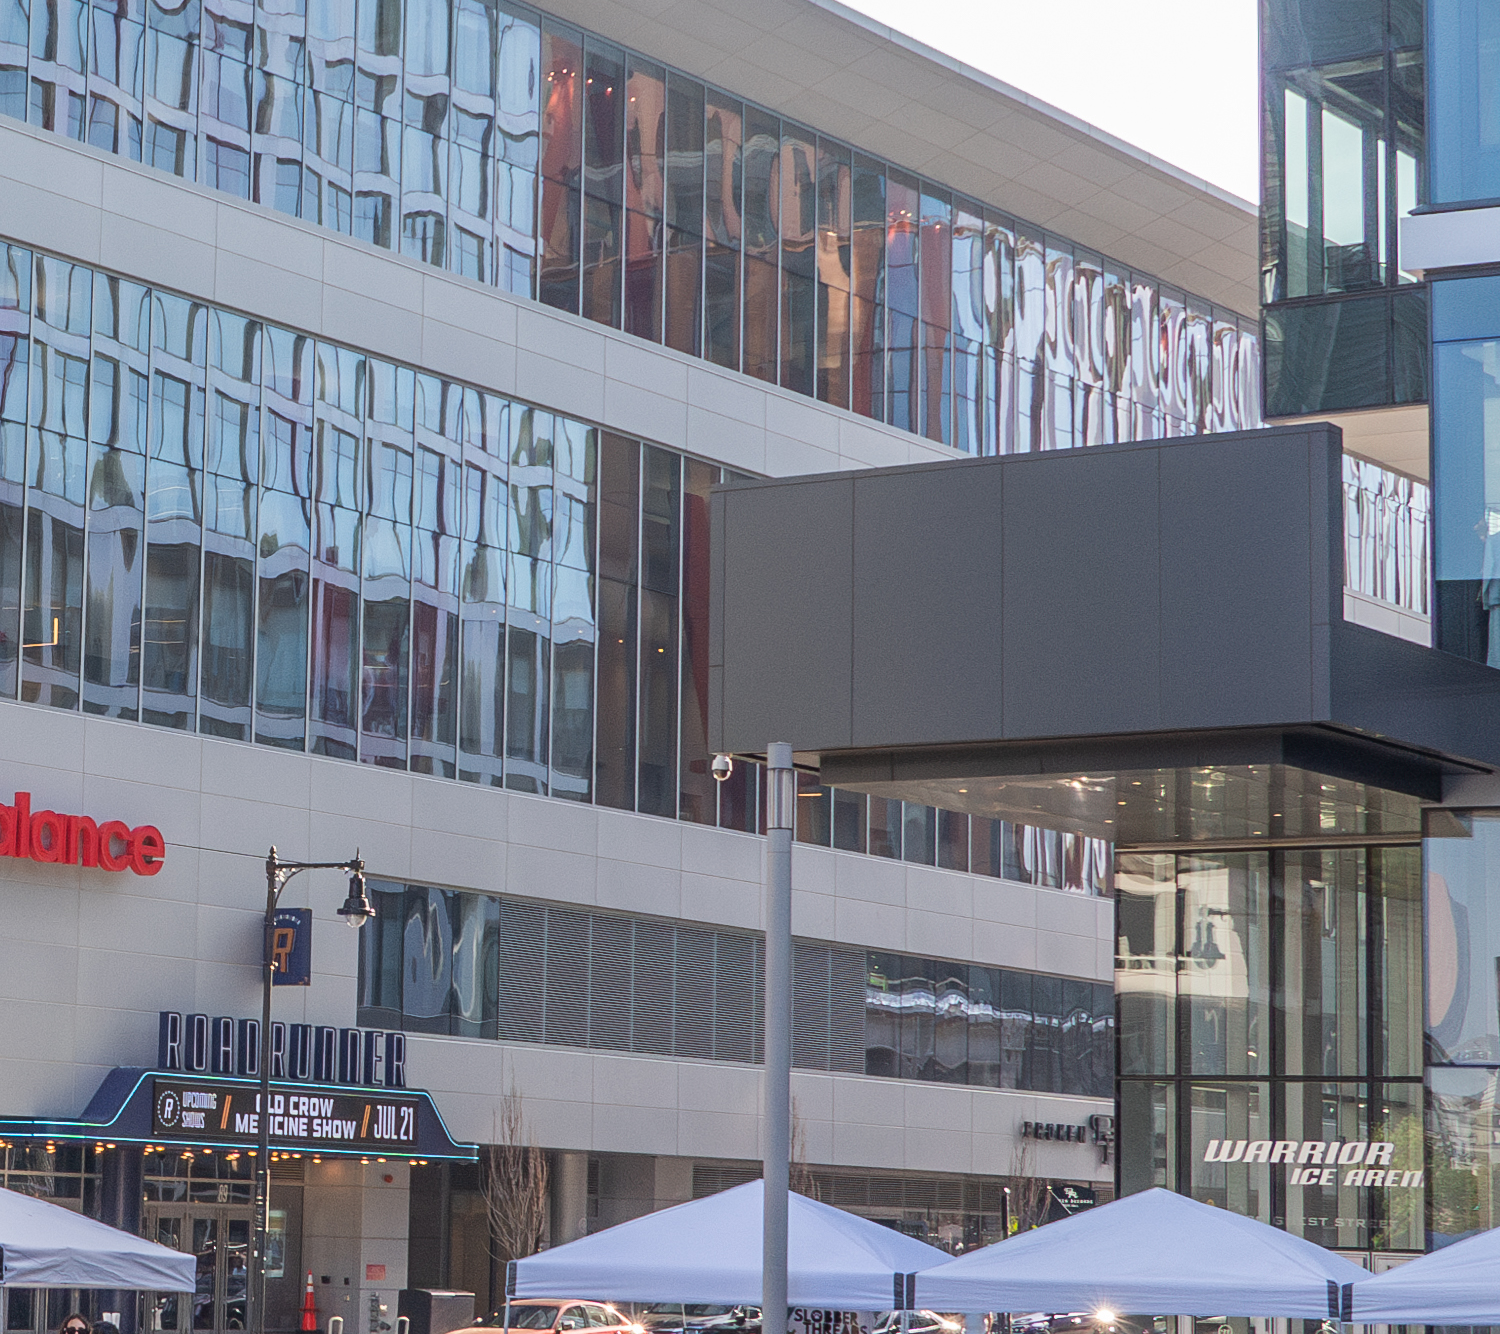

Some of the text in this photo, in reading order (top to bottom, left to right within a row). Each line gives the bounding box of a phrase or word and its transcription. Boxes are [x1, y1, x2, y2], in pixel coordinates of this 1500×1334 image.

[159, 1011, 407, 1088] ROADRUNNER
[182, 1091, 217, 1110] UPCOMING
[289, 1095, 334, 1118] CROW
[182, 1111, 206, 1129] SHOWS
[235, 1113, 357, 1140] MEICINE SHOW
[374, 1105, 414, 1141] JUL 21
[1203, 1139, 1395, 1166] WARRIOR
[1289, 1167, 1425, 1188] ICE AREN
[217, 1184, 229, 1203] 89
[793, 1308, 858, 1326] SLOBBER
